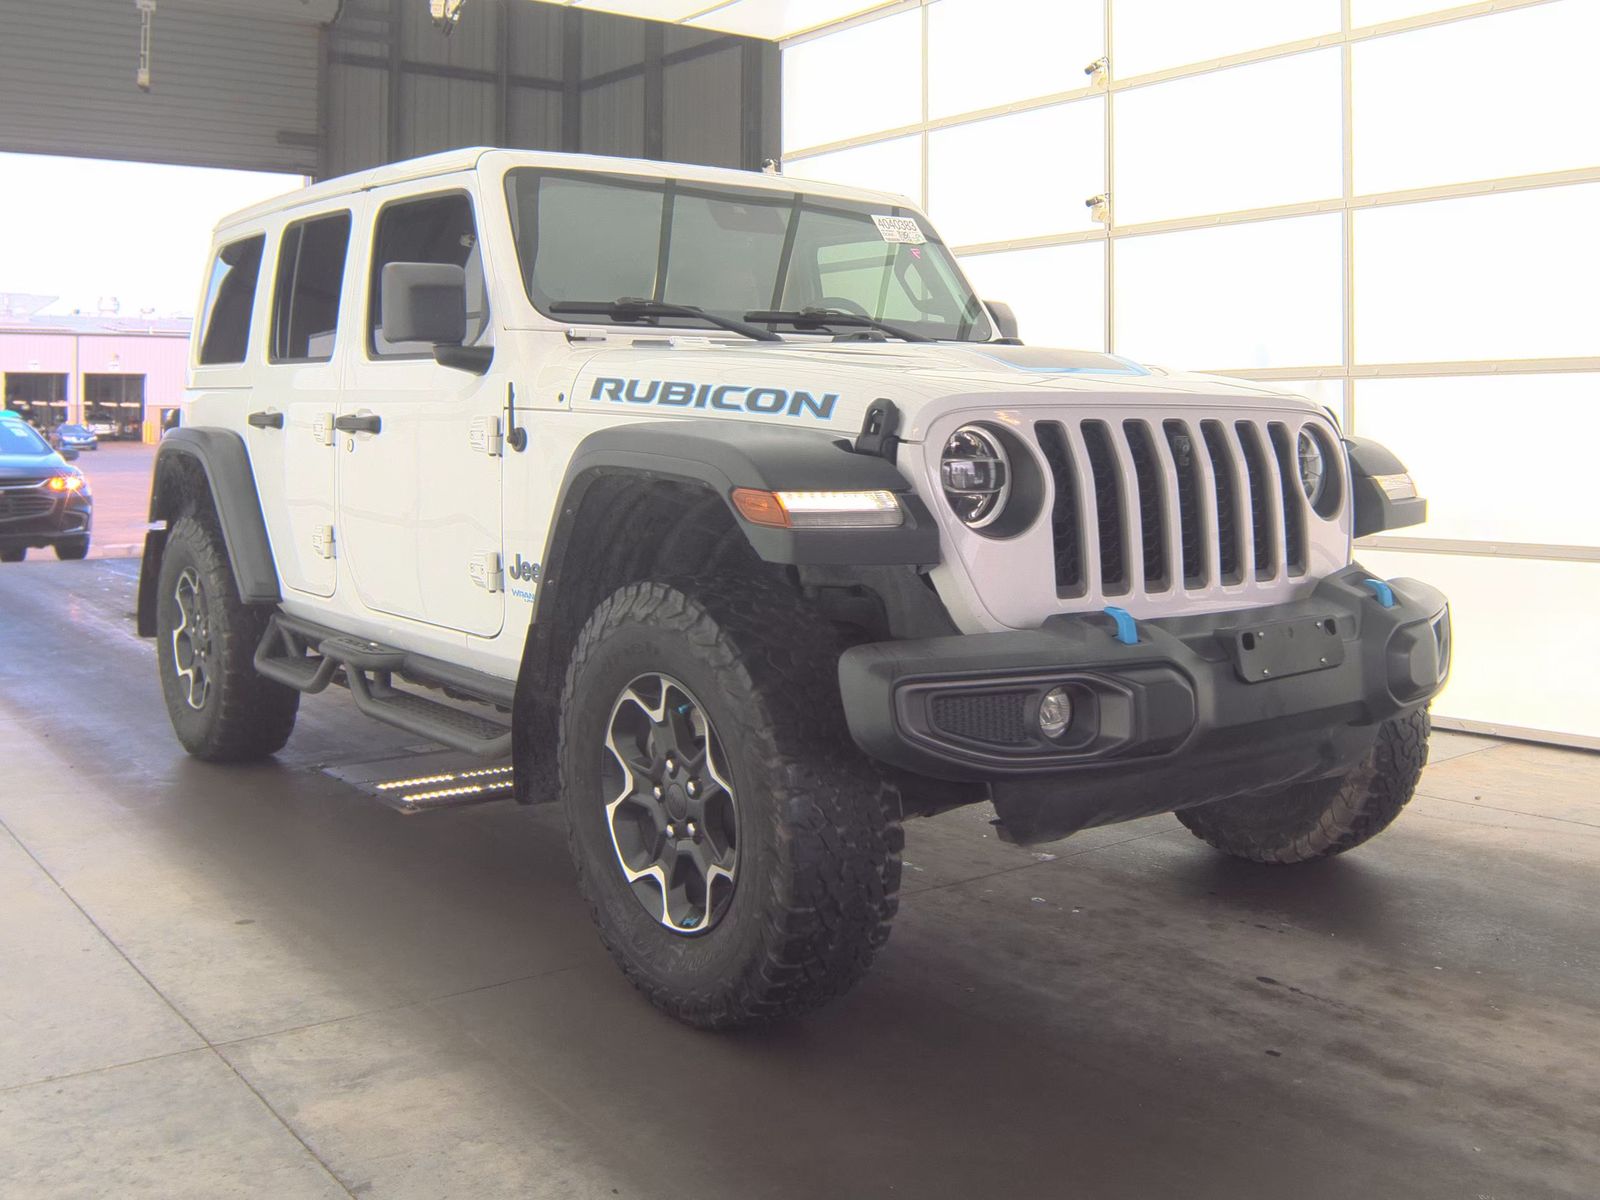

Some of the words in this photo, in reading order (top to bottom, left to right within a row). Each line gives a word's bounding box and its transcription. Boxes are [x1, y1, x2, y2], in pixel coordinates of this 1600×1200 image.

[878, 218, 917, 231] 4040383
[590, 377, 839, 420] RUBICON
[509, 553, 542, 584] Jee
